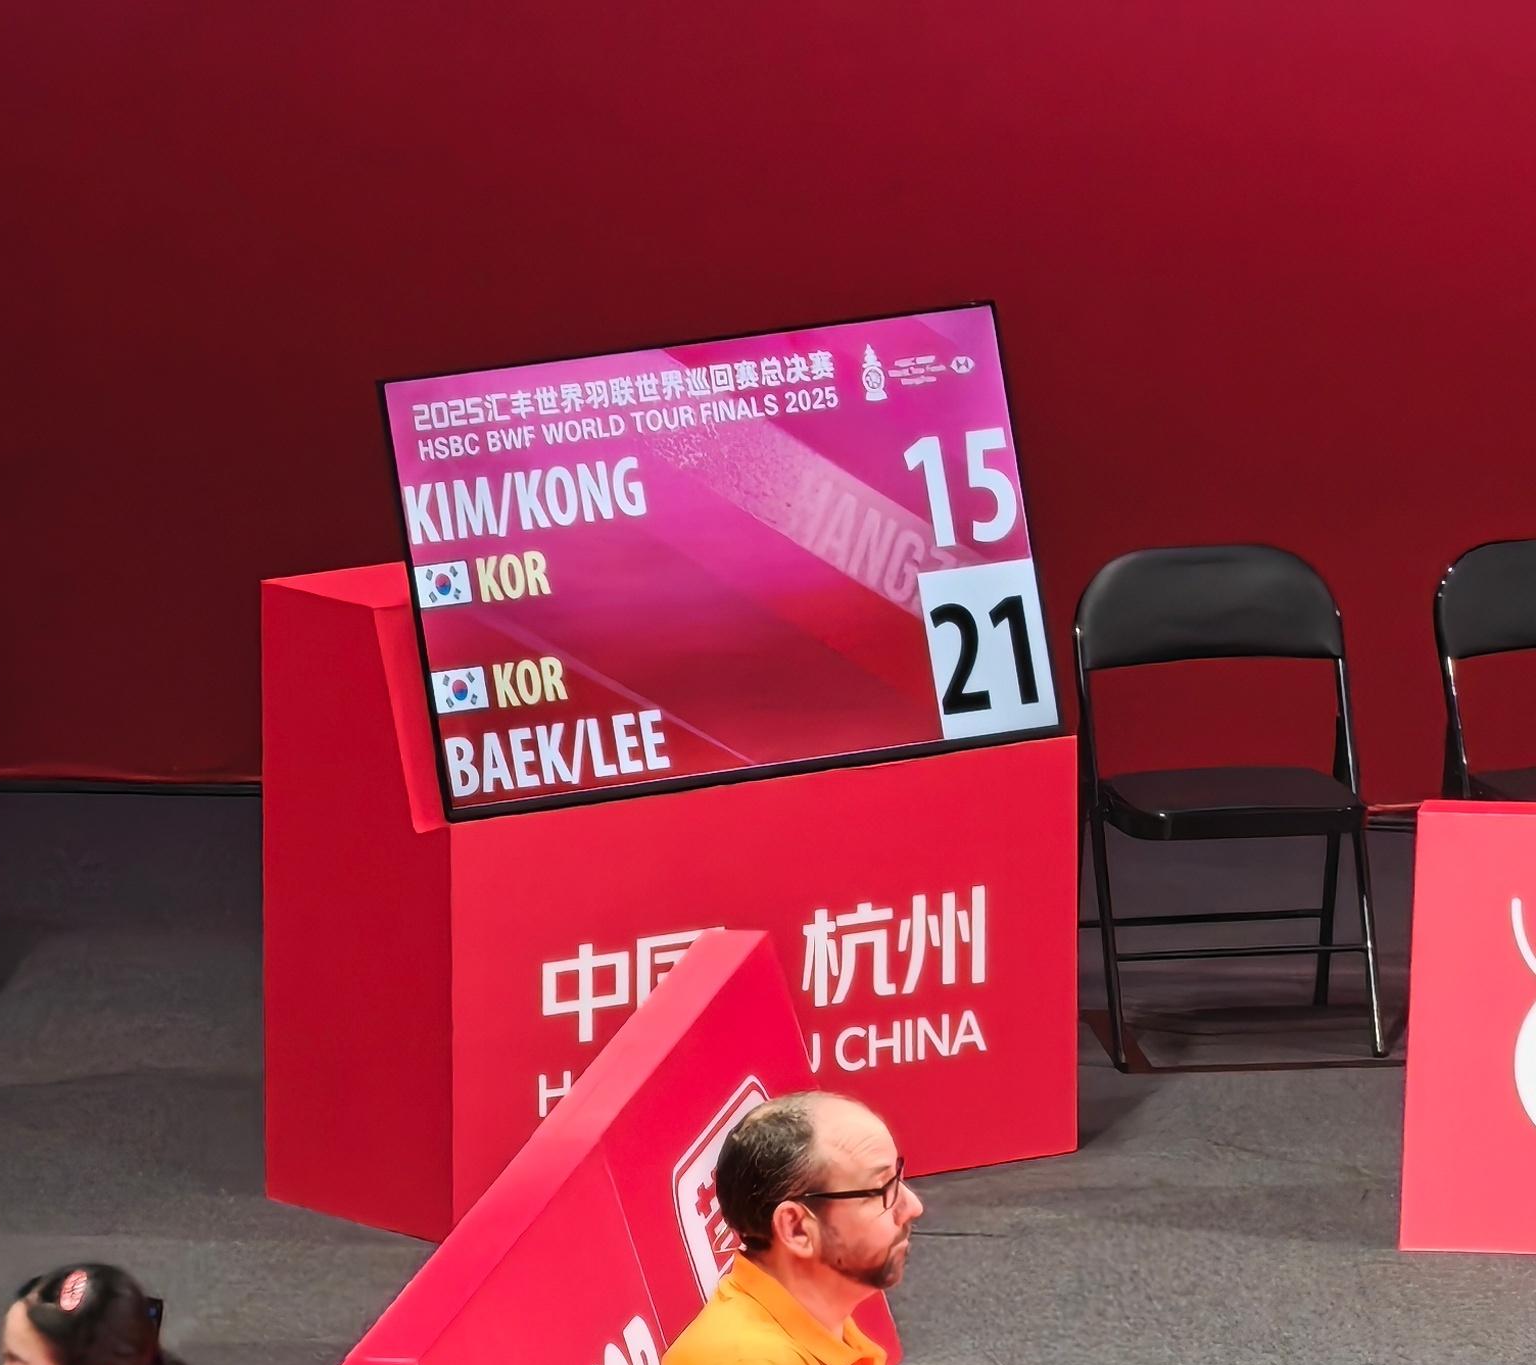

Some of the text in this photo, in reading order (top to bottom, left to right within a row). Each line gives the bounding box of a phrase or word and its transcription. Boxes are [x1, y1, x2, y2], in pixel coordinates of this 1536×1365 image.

[412, 350, 834, 431] 2025汇丰世界羽联世界巡回赛总决赛
[418, 386, 839, 461] HSBC BWF WORLD TOUR FINALS 2025
[404, 456, 647, 545] KIM/KONG
[904, 427, 1017, 549] 15
[475, 551, 551, 603] KOR
[492, 655, 568, 708] KOR
[929, 594, 1040, 716] 21
[443, 709, 671, 798] BAEK/LEE
[802, 885, 986, 1008] 杭州
[834, 1010, 987, 1072] CHINA
